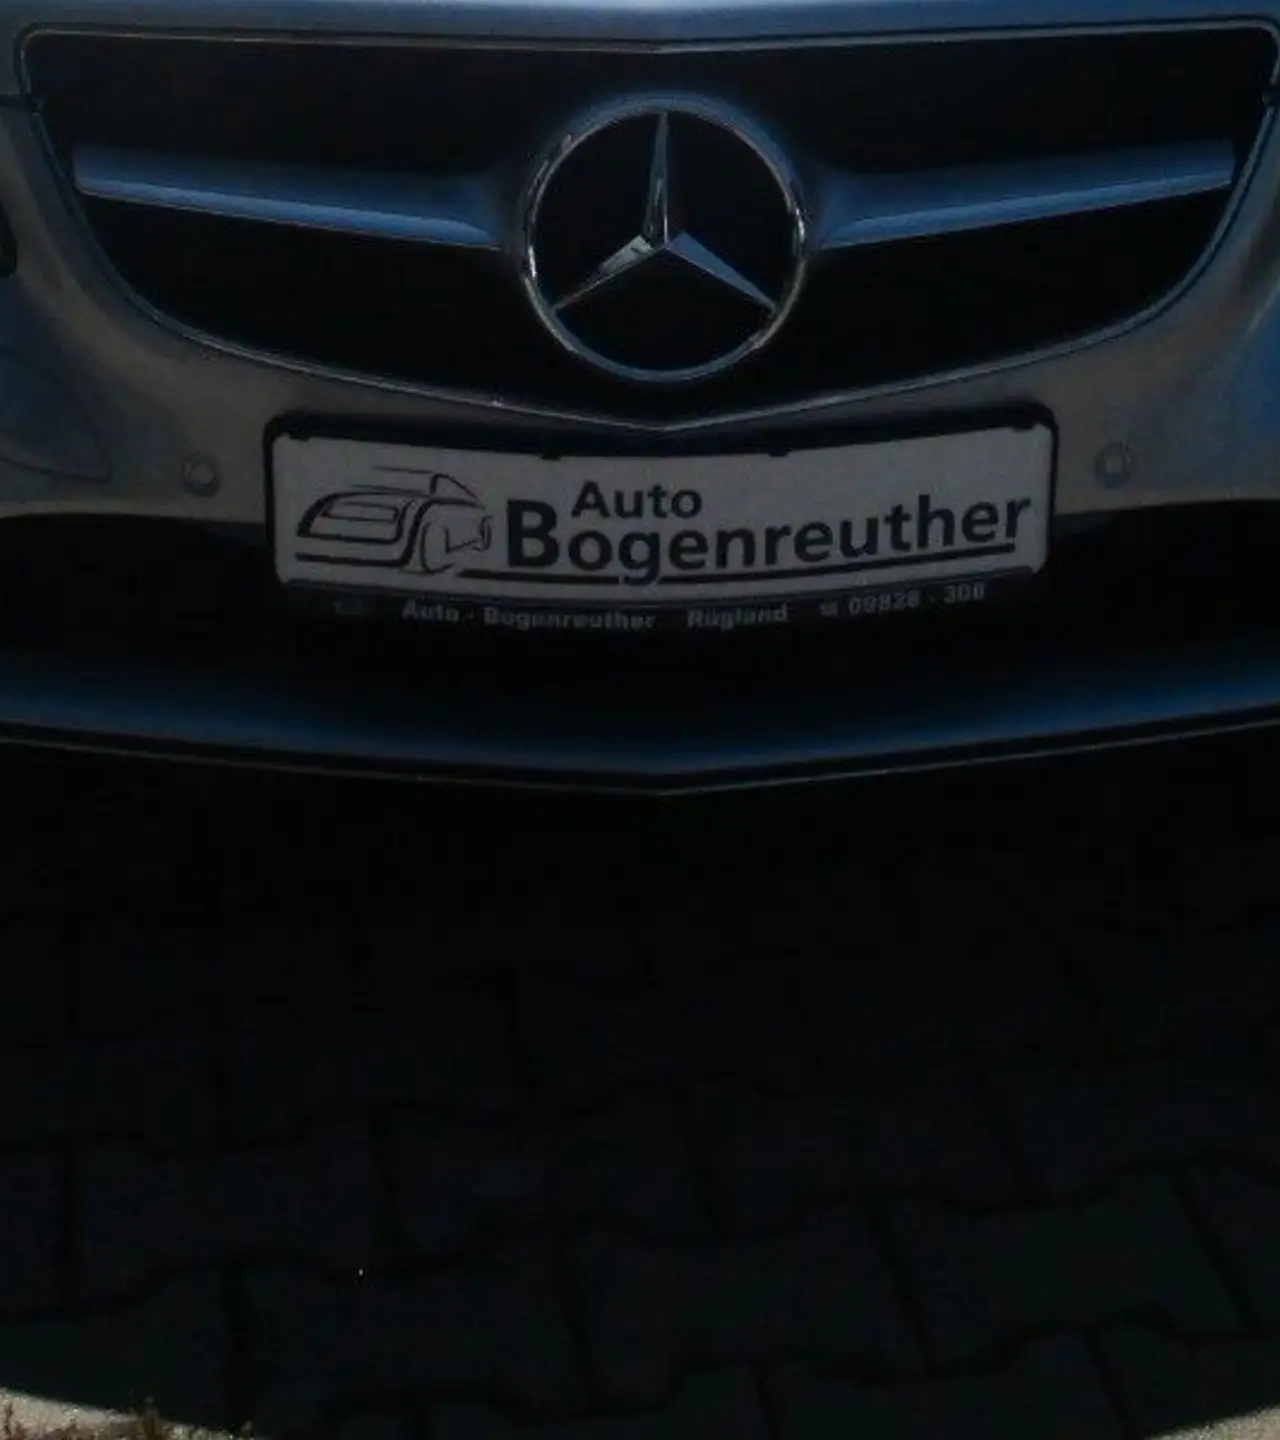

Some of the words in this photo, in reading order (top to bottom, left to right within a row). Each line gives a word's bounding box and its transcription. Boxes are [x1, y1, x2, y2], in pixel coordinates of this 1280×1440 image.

[571, 480, 703, 520] Auto
[505, 494, 1032, 586] Bogenreuther
[401, 599, 460, 623] Auto
